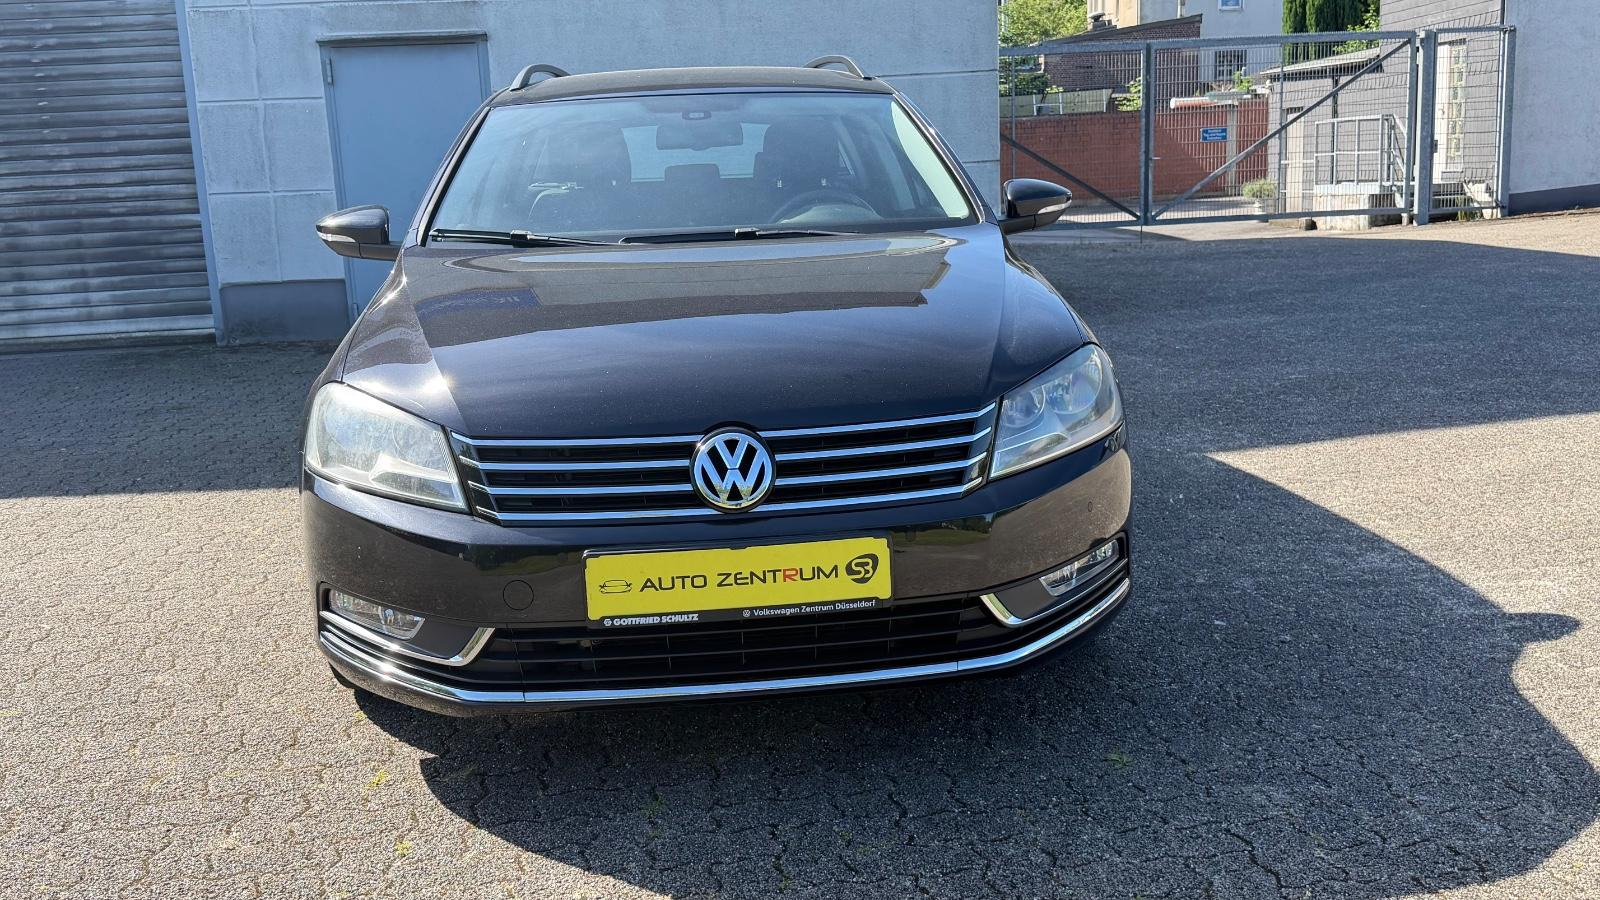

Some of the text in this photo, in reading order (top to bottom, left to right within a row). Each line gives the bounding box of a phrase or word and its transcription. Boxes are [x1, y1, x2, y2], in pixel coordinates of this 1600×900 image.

[639, 574, 708, 592] AUTO
[716, 564, 839, 588] ZENTRUM
[753, 606, 800, 617] Volkswagen
[801, 604, 834, 613] Zentrum
[835, 599, 876, 610] Düsseldorf
[613, 613, 699, 626] GOTTFRIED SCHULTZ
